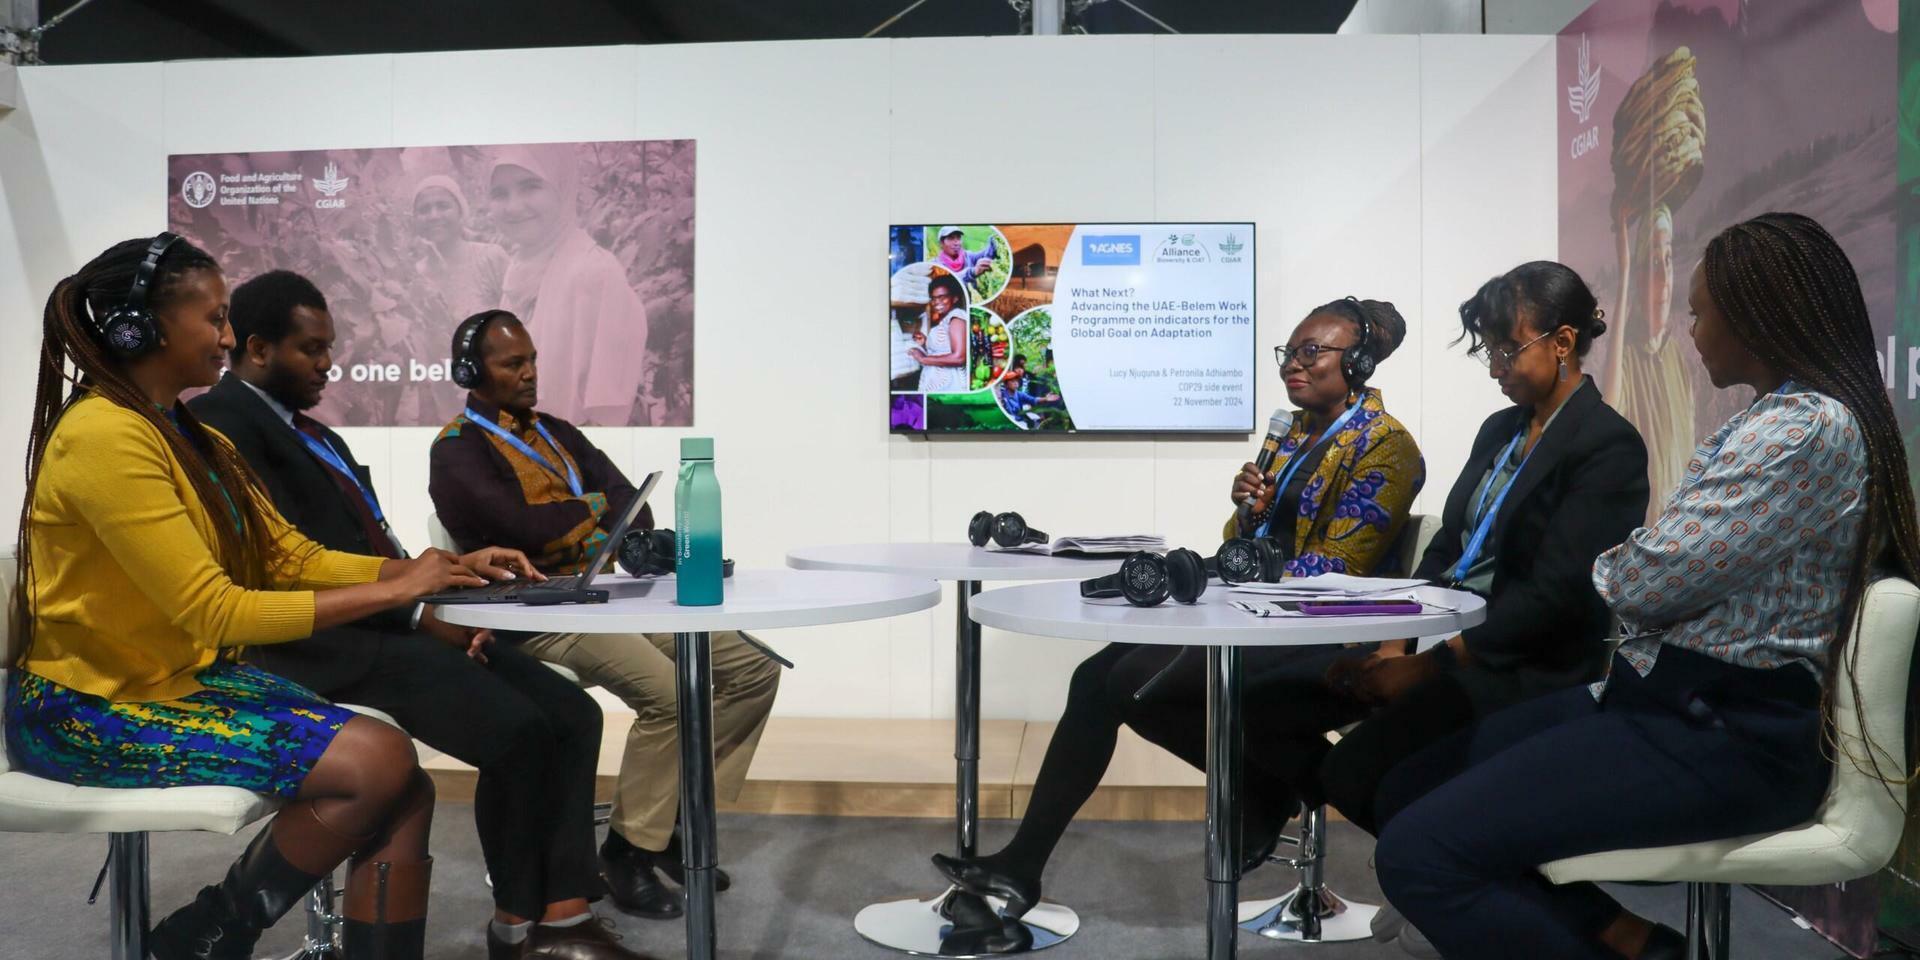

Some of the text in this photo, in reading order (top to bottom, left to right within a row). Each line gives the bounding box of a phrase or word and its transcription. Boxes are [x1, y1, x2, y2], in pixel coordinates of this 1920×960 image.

[1571, 126, 1599, 159] CGIAR
[220, 172, 302, 184] Food and Agriculture
[220, 184, 296, 195] Organization of the
[220, 197, 247, 205] United
[249, 196, 279, 204] Nations
[315, 199, 345, 208] CGIAR
[1097, 243, 1133, 253] AGNES
[1162, 248, 1200, 257] Alliance
[1071, 288, 1135, 297] What Next?
[1071, 302, 1247, 313] Advancing the UAE-Belem Work
[1071, 315, 1135, 327] Programme
[1154, 315, 1210, 325] indicators
[1213, 315, 1229, 325] for
[1232, 315, 1250, 325] the
[1071, 328, 1104, 338] Global
[1107, 328, 1132, 338] Goal
[1151, 328, 1212, 340] Adaptation
[327, 359, 452, 382] o one bel
[1109, 369, 1127, 379] Lucy
[1205, 369, 1243, 377] Adhiambo
[1178, 383, 1243, 392] COP29 side event
[1173, 397, 1243, 406] 22 November 2024
